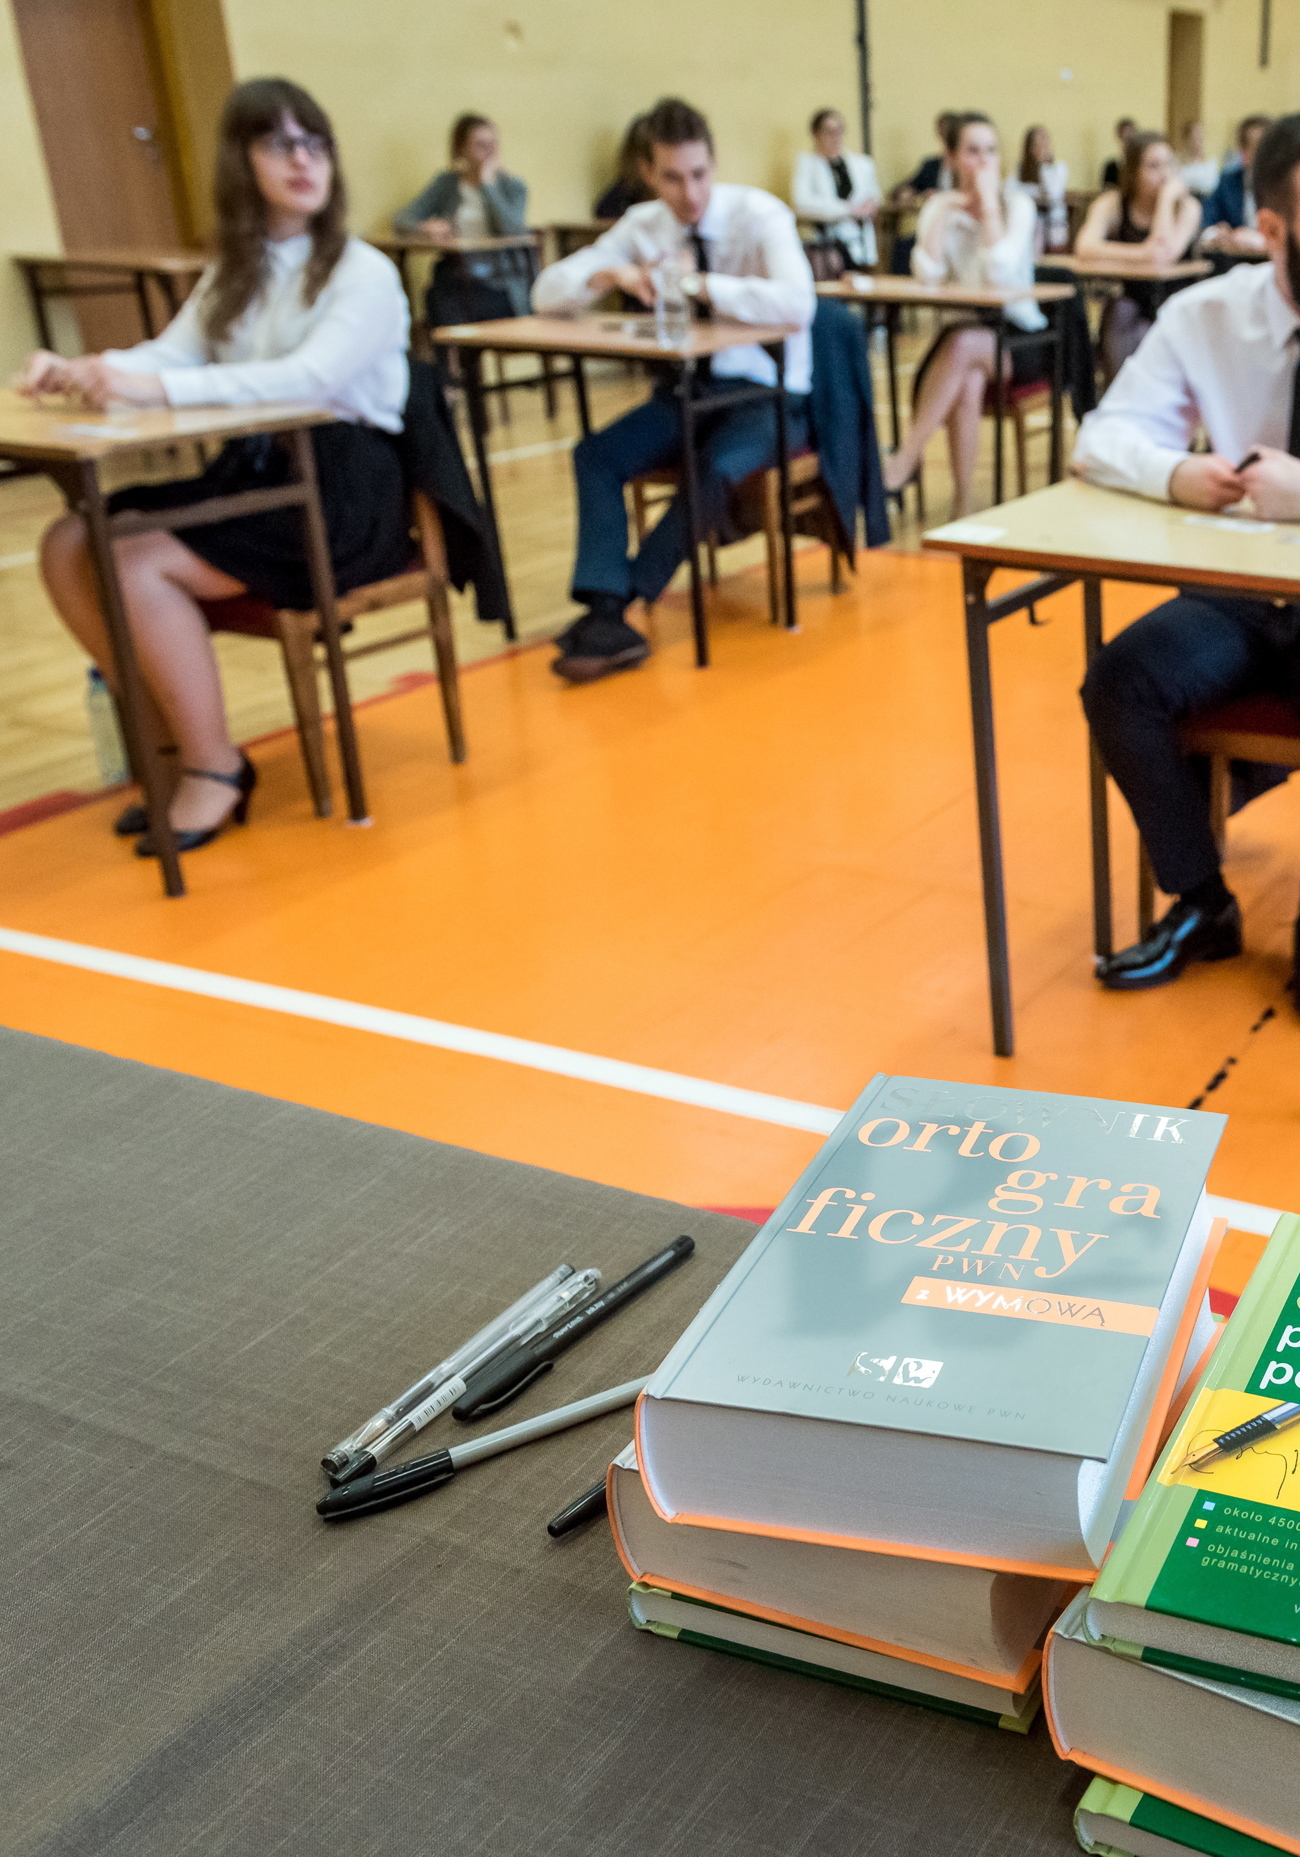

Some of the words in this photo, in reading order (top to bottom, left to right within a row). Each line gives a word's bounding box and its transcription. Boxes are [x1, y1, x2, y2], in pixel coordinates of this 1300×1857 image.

[857, 1117, 1041, 1163] orto
[988, 1169, 1162, 1219] gra
[786, 1187, 1110, 1278] ficzny
[929, 1254, 1025, 1281] PWN
[915, 1288, 931, 1300] z
[944, 1284, 1106, 1327] WYMOWĄ
[736, 1373, 876, 1400] WYDAWNICTWO
[885, 1393, 977, 1415] NAUKOWE
[986, 1407, 1027, 1420] PWN
[1206, 1542, 1295, 1571] objaśnienia
[1215, 1523, 1280, 1546] aktualne
